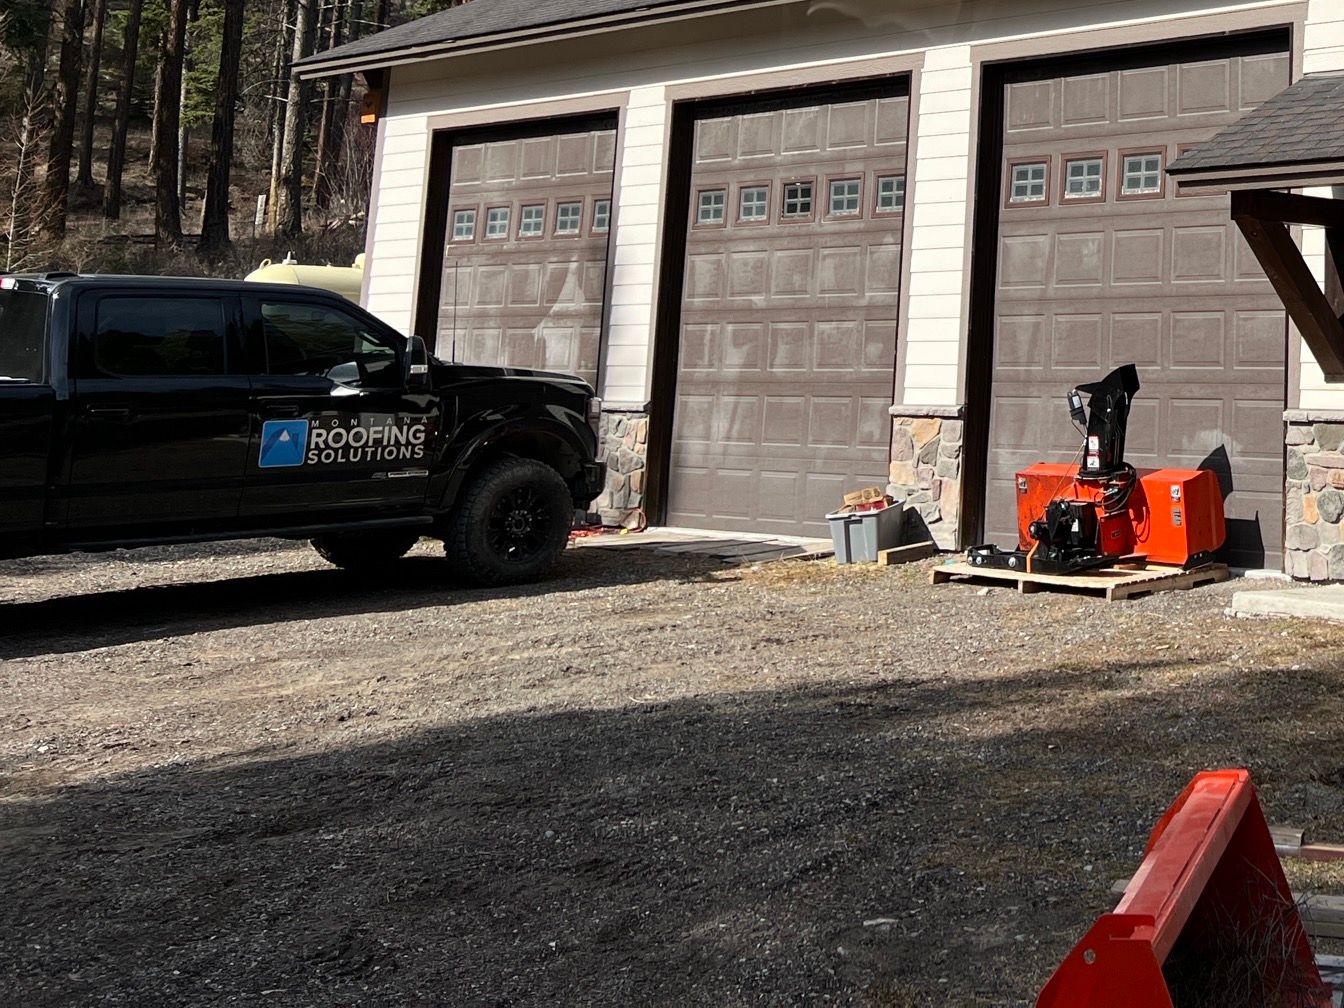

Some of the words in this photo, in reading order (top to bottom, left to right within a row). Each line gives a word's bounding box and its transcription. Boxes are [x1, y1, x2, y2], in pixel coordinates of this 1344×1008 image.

[311, 416, 427, 427] MONTANA
[310, 425, 426, 449] ROOFING
[307, 445, 424, 464] SOLUTIONS
